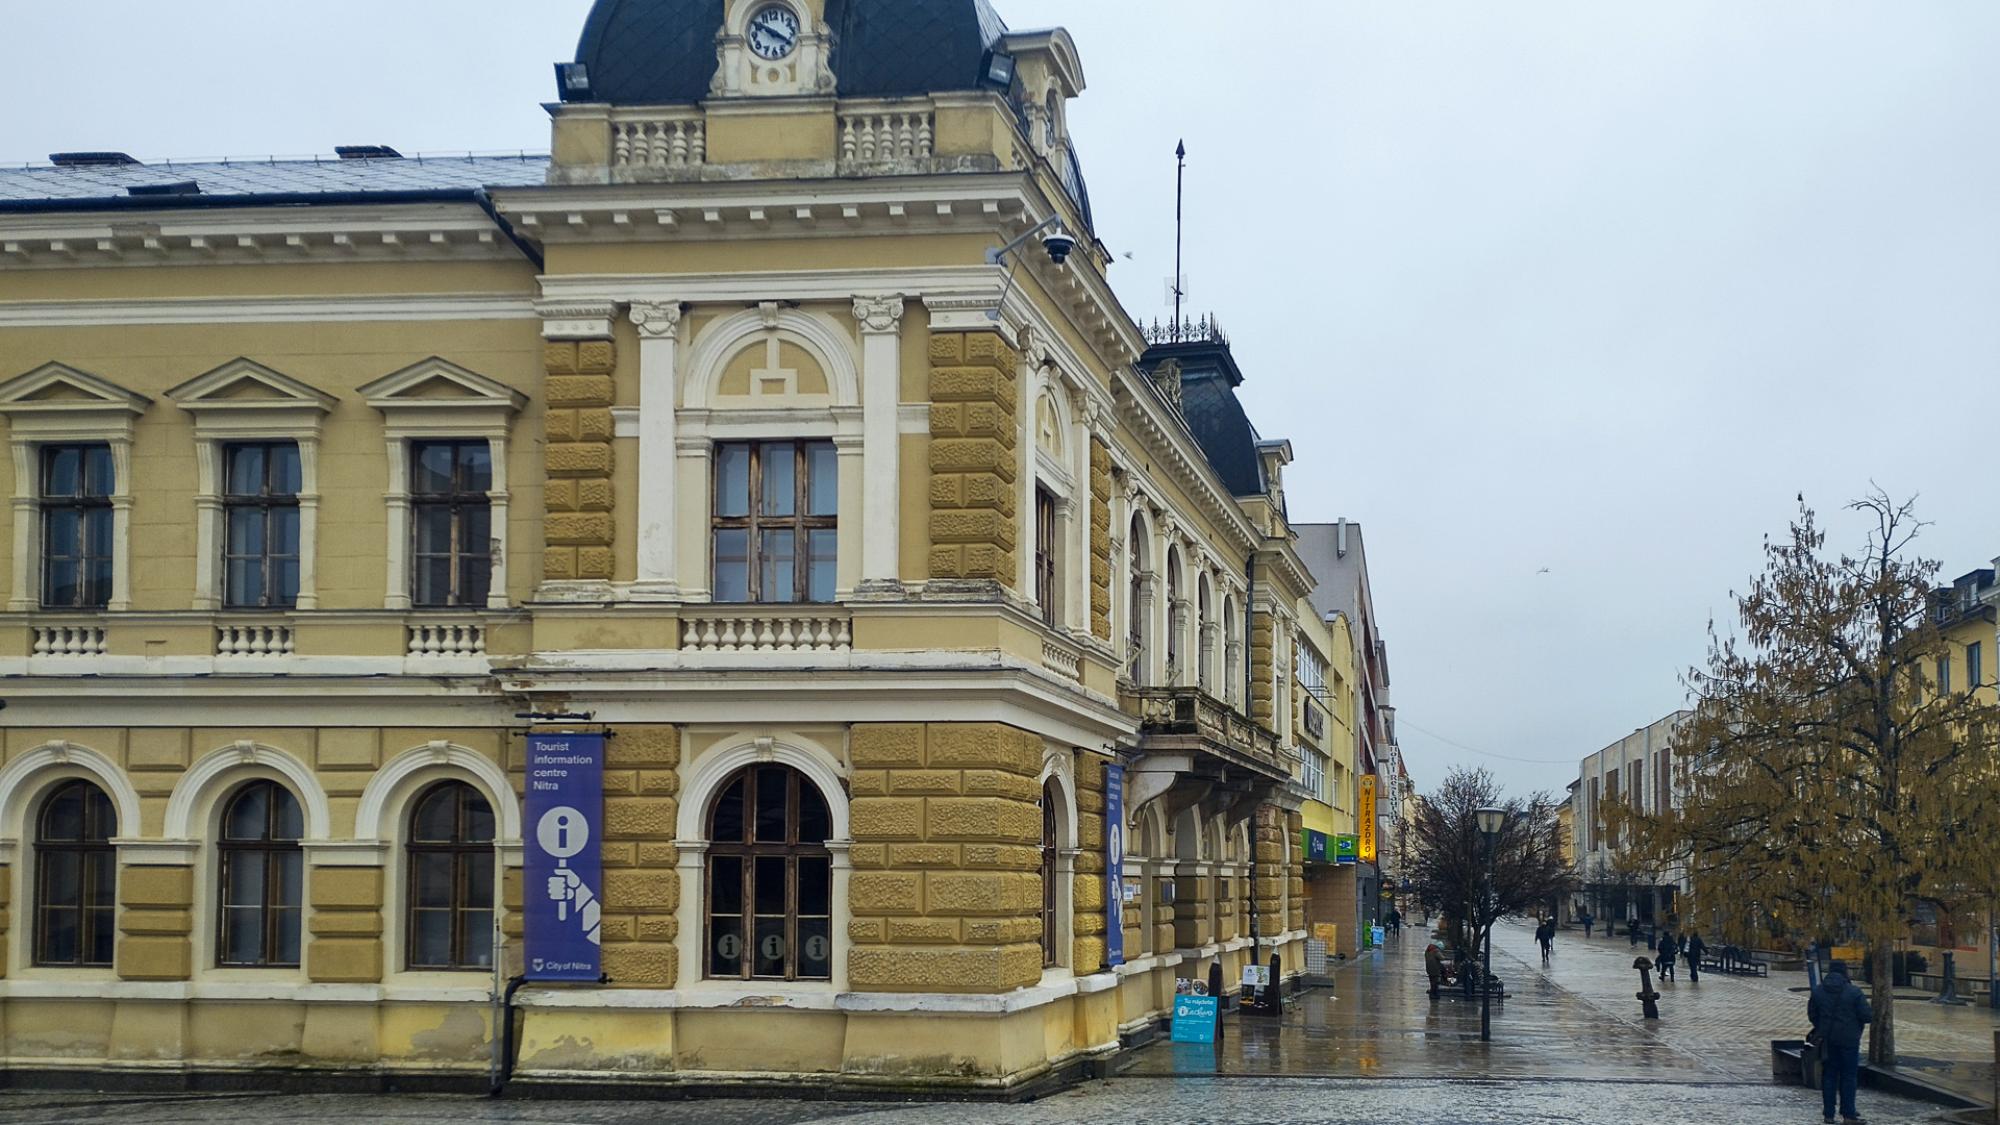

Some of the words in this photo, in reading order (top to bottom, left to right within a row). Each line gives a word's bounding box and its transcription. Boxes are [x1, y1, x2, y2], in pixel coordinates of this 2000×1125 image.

[769, 10, 779, 21] 12
[780, 12, 784, 22] 1
[763, 46, 770, 56] 7
[535, 742, 569, 751] Tourist
[534, 755, 593, 765] information
[533, 769, 568, 777] centre
[533, 781, 559, 790] Nitra
[1364, 789, 1372, 859] NITRAZDROJ
[546, 961, 561, 971] City
[562, 962, 571, 970] of
[572, 962, 592, 970] Nitra
